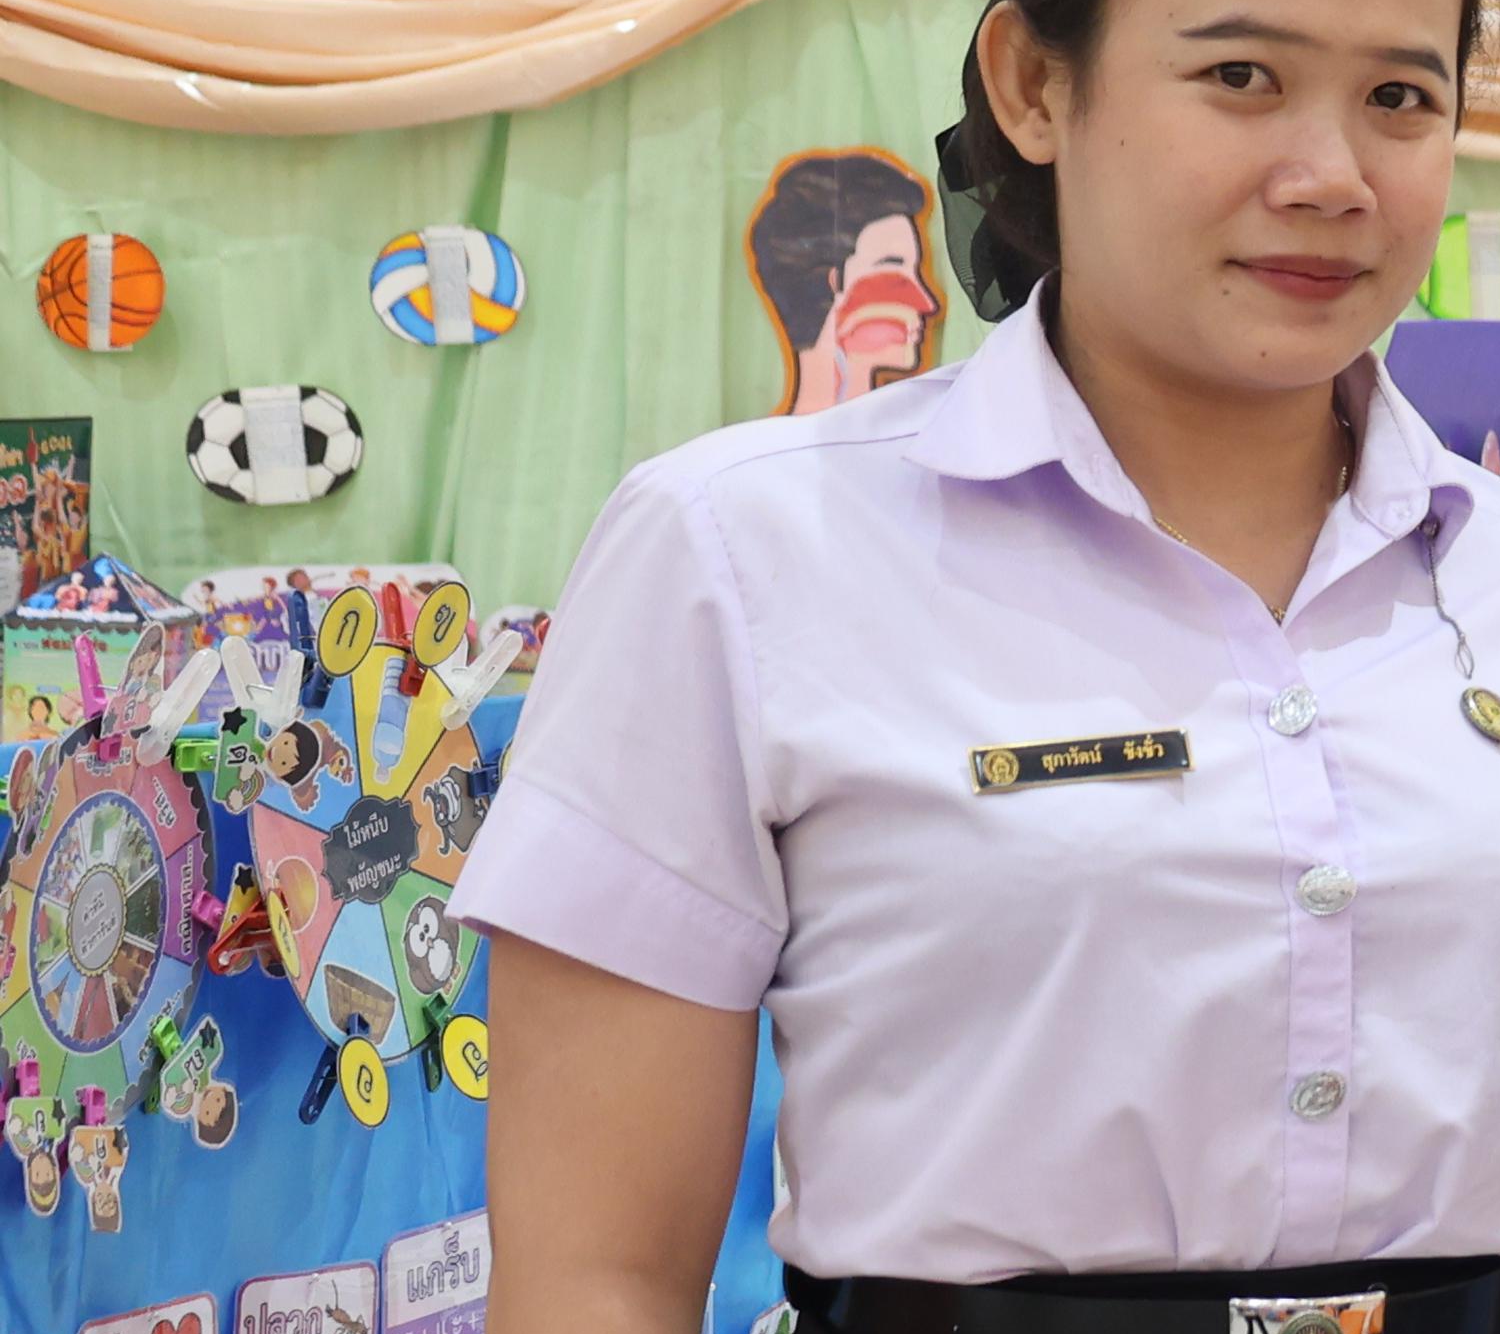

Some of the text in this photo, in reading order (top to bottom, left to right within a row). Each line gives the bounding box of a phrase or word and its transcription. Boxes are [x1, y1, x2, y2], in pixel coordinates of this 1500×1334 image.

[343, 812, 389, 849] ไม้หนีบ
[347, 853, 402, 893] พยัญชนะ
